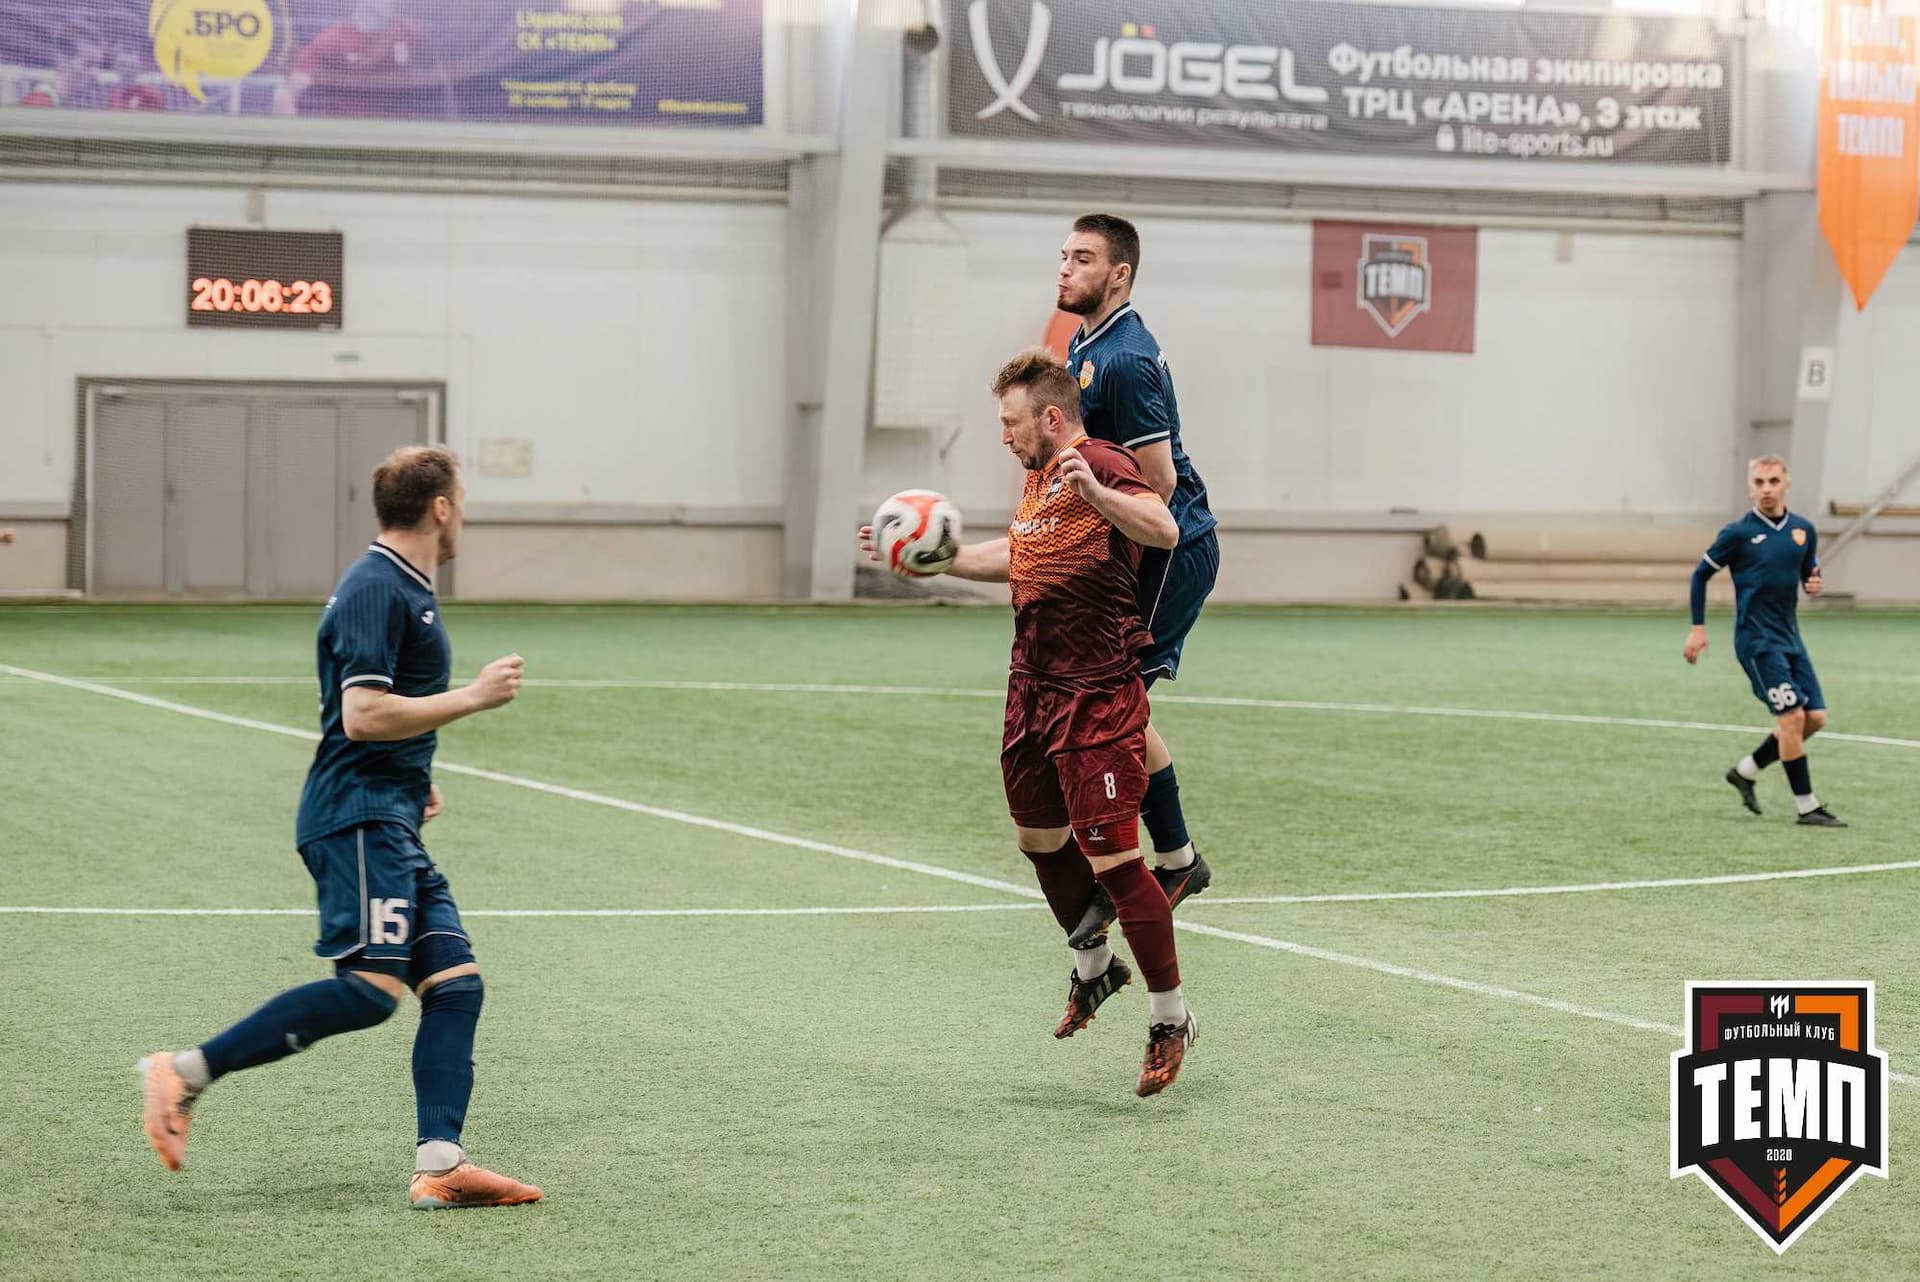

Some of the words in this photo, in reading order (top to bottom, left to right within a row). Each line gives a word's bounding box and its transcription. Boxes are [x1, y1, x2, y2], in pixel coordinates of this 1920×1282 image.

[1328, 42, 1530, 84] Футбольная
[1535, 57, 1724, 94] экипировка
[1342, 85, 1417, 126] ТРЦ
[1422, 91, 1591, 131] «АРЕНА»,
[1624, 105, 1701, 129] этаж
[1462, 124, 1614, 159] lite-sports.ru
[191, 277, 333, 313] 20:06:23
[1365, 262, 1425, 299] ТЕМП
[1768, 682, 1797, 710] 96
[1104, 772, 1117, 800] 8
[370, 898, 409, 944] 15
